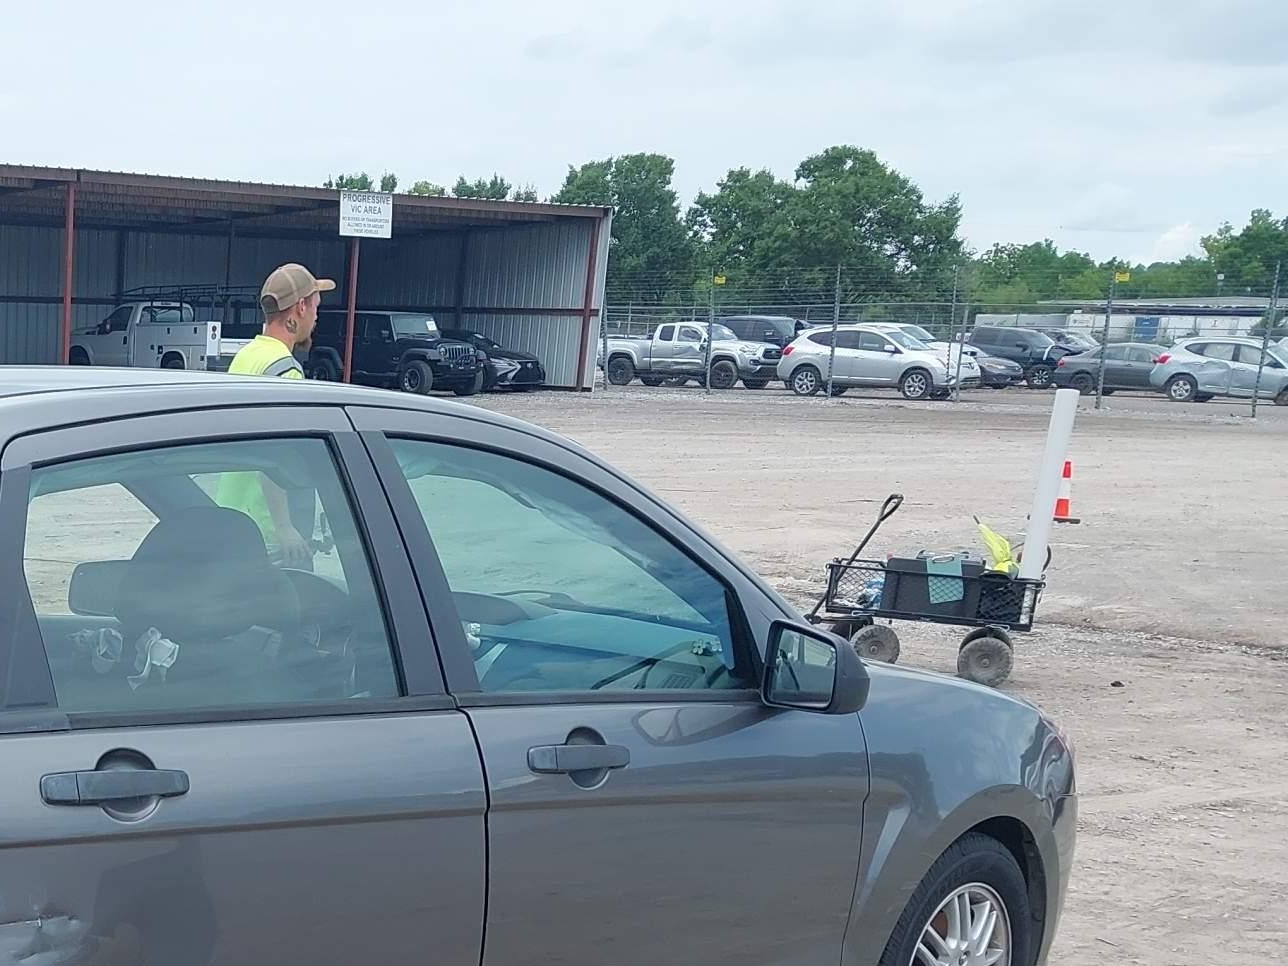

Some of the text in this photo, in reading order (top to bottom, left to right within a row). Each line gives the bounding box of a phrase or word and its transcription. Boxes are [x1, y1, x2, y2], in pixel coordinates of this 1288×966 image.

[342, 193, 391, 205] PROGRESSIVE
[351, 204, 382, 215] VIC AREA
